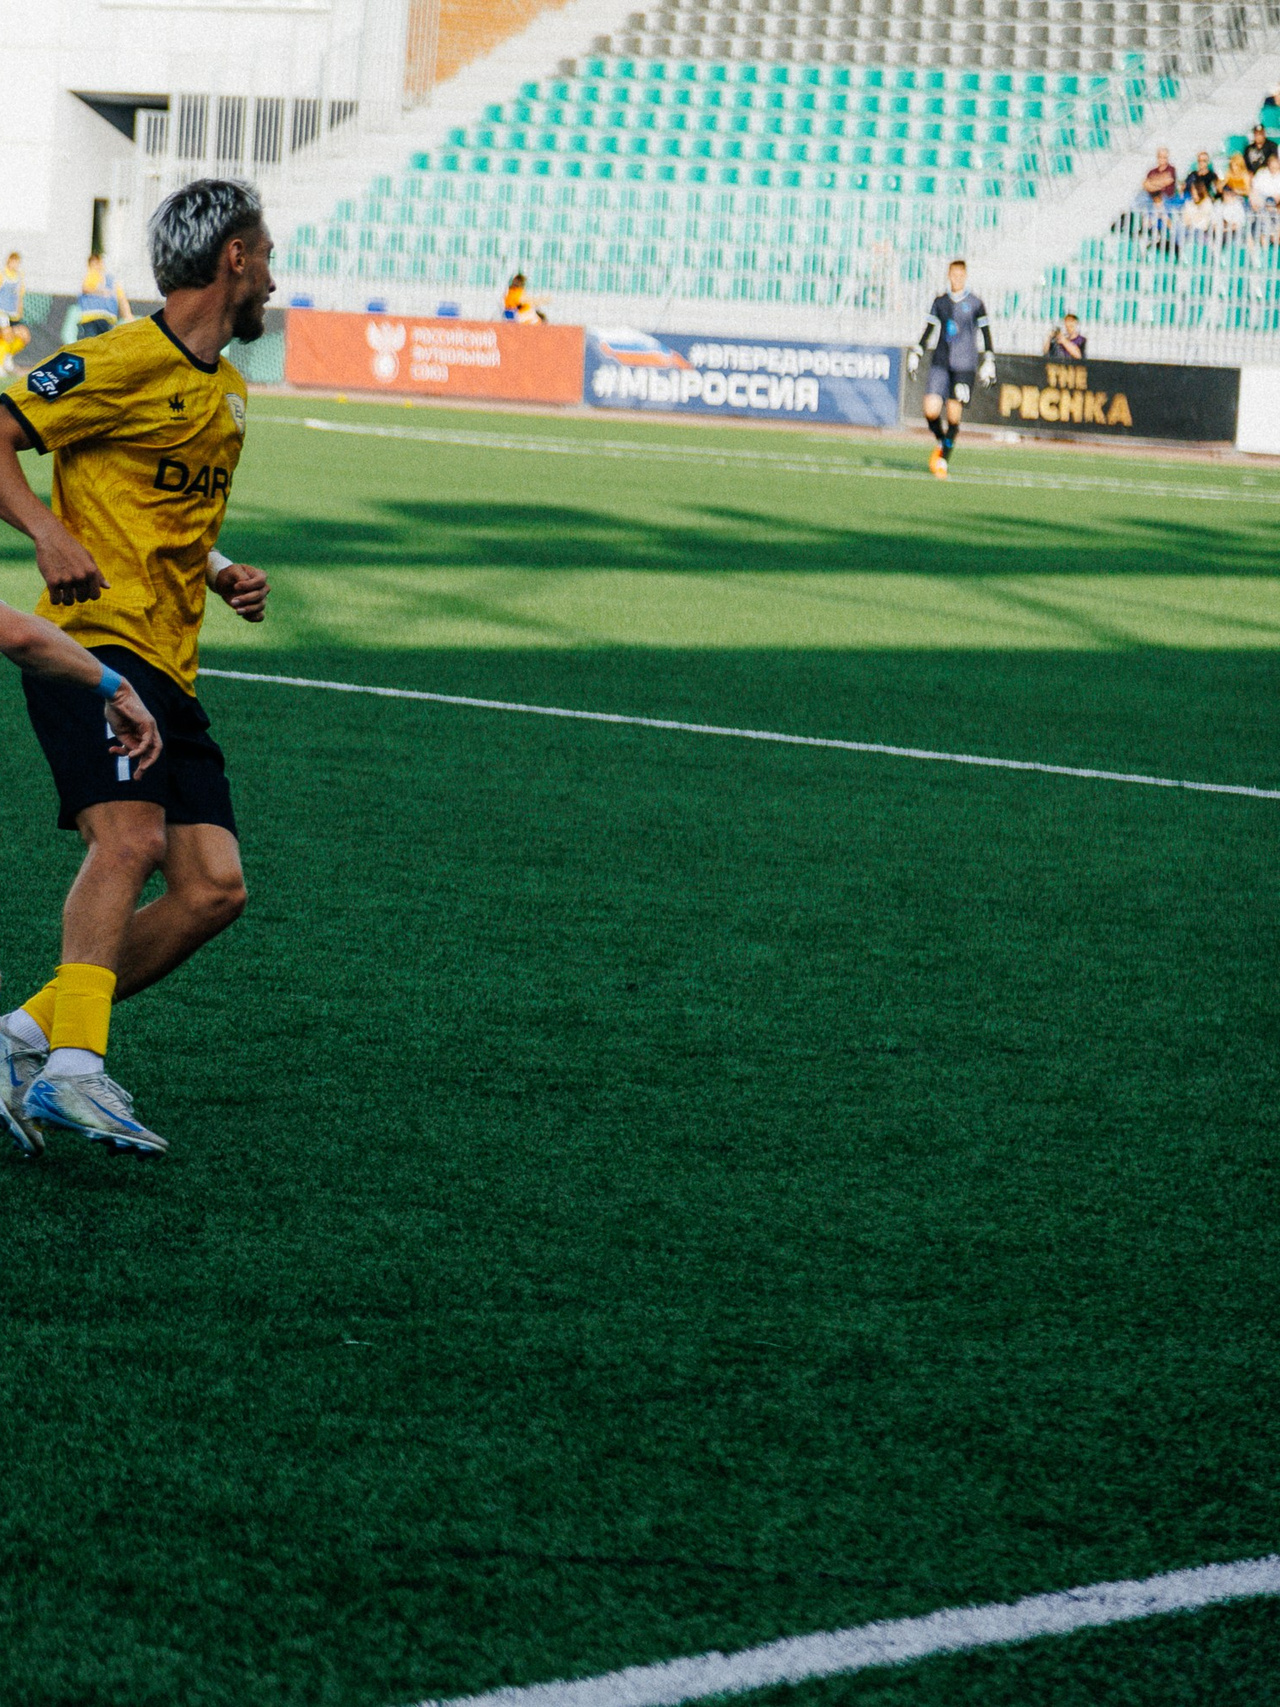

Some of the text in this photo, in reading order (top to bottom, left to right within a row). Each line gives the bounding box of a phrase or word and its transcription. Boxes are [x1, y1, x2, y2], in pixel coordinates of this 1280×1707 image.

[689, 342, 891, 380] #ВПЕРЕДРОССИЯ
[1046, 362, 1089, 390] THE
[591, 362, 820, 413] #МЫРОССИЯ
[999, 383, 1134, 428] PECHKA
[153, 458, 235, 503] DAR
